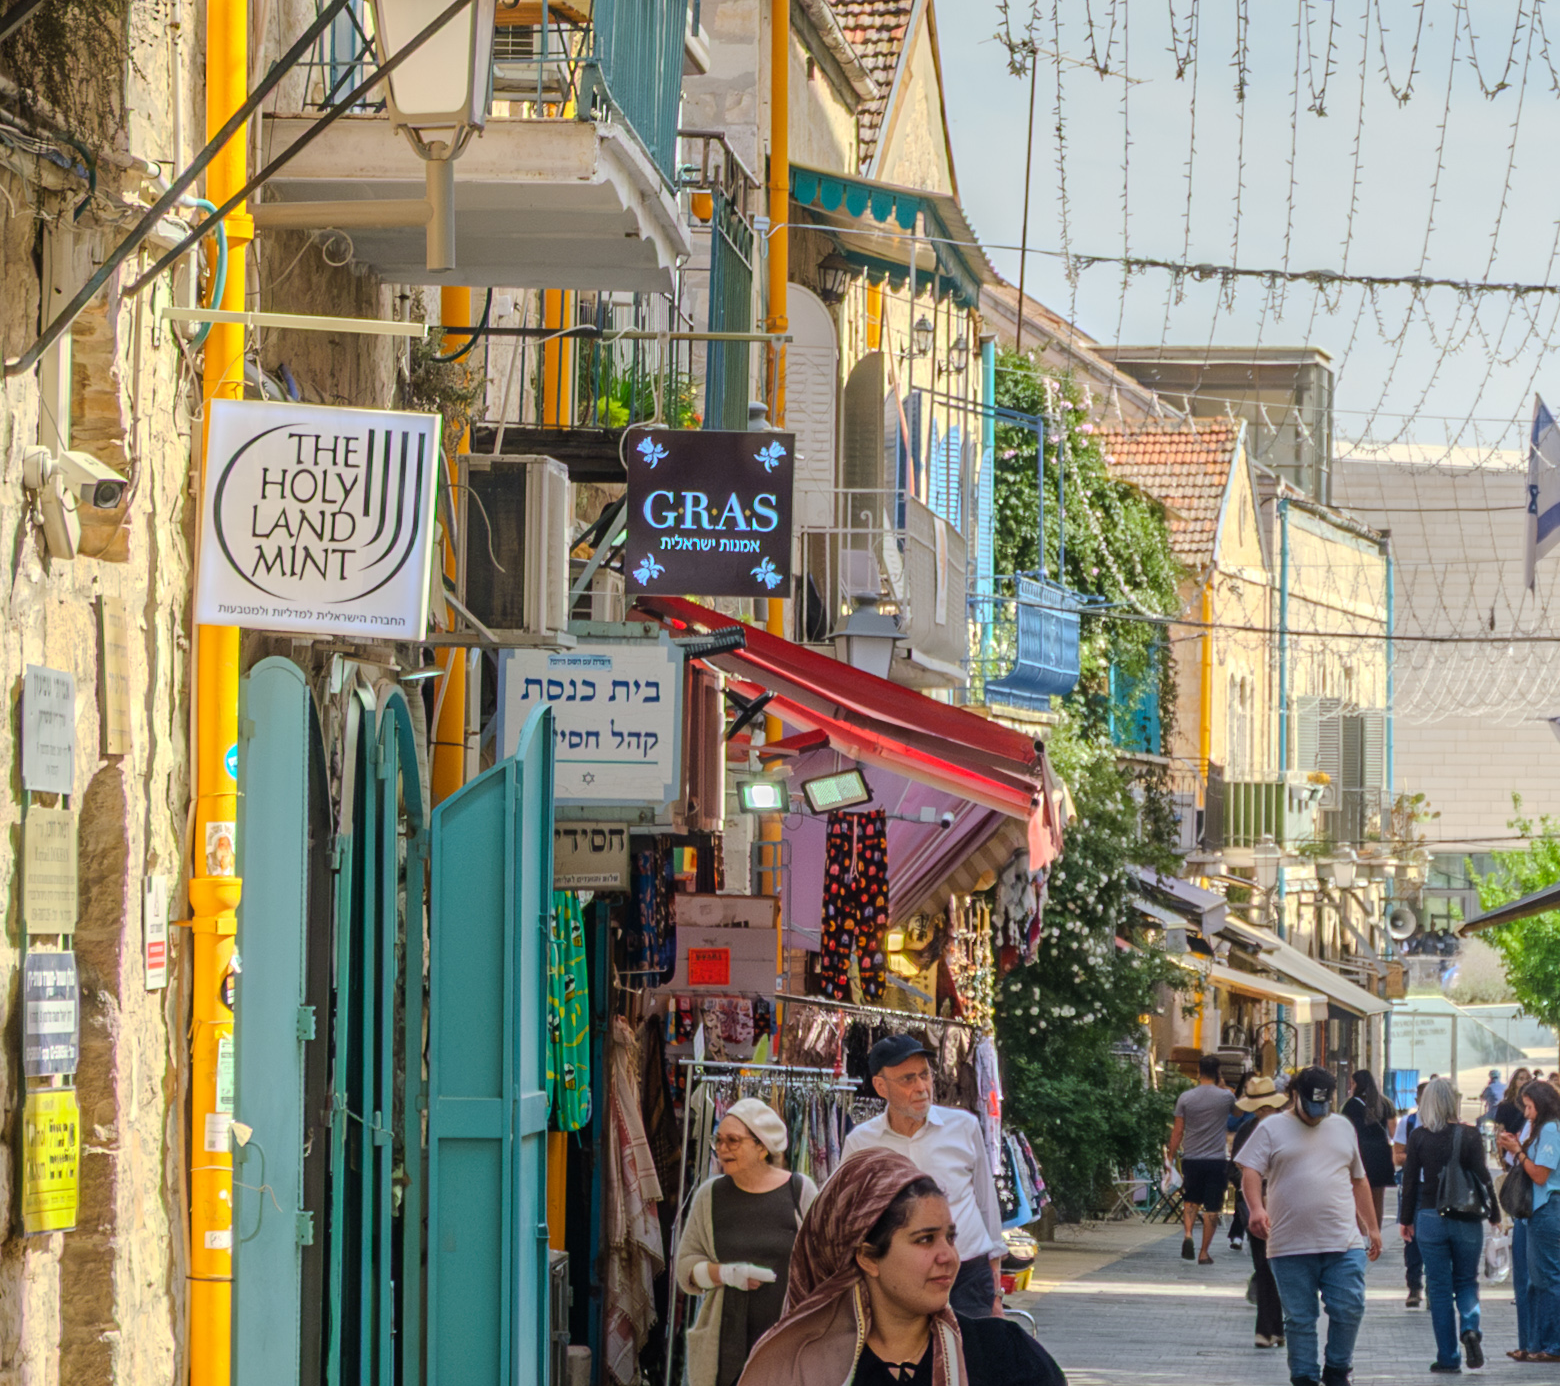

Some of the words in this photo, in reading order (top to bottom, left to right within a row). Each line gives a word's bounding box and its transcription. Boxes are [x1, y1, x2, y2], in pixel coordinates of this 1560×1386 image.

[288, 432, 360, 468] THE
[261, 467, 359, 512] HOLY
[251, 504, 356, 544] LAND
[659, 533, 716, 552] ישראלית
[718, 539, 761, 553] אמנות
[251, 543, 357, 581] MINT
[217, 603, 269, 616] ולמטבעות
[271, 607, 313, 619] למדליות
[316, 610, 367, 623] הישראלית
[370, 616, 406, 626] החברה
[520, 677, 596, 702] כנסת
[608, 679, 661, 703] בית
[610, 718, 659, 758] קהל
